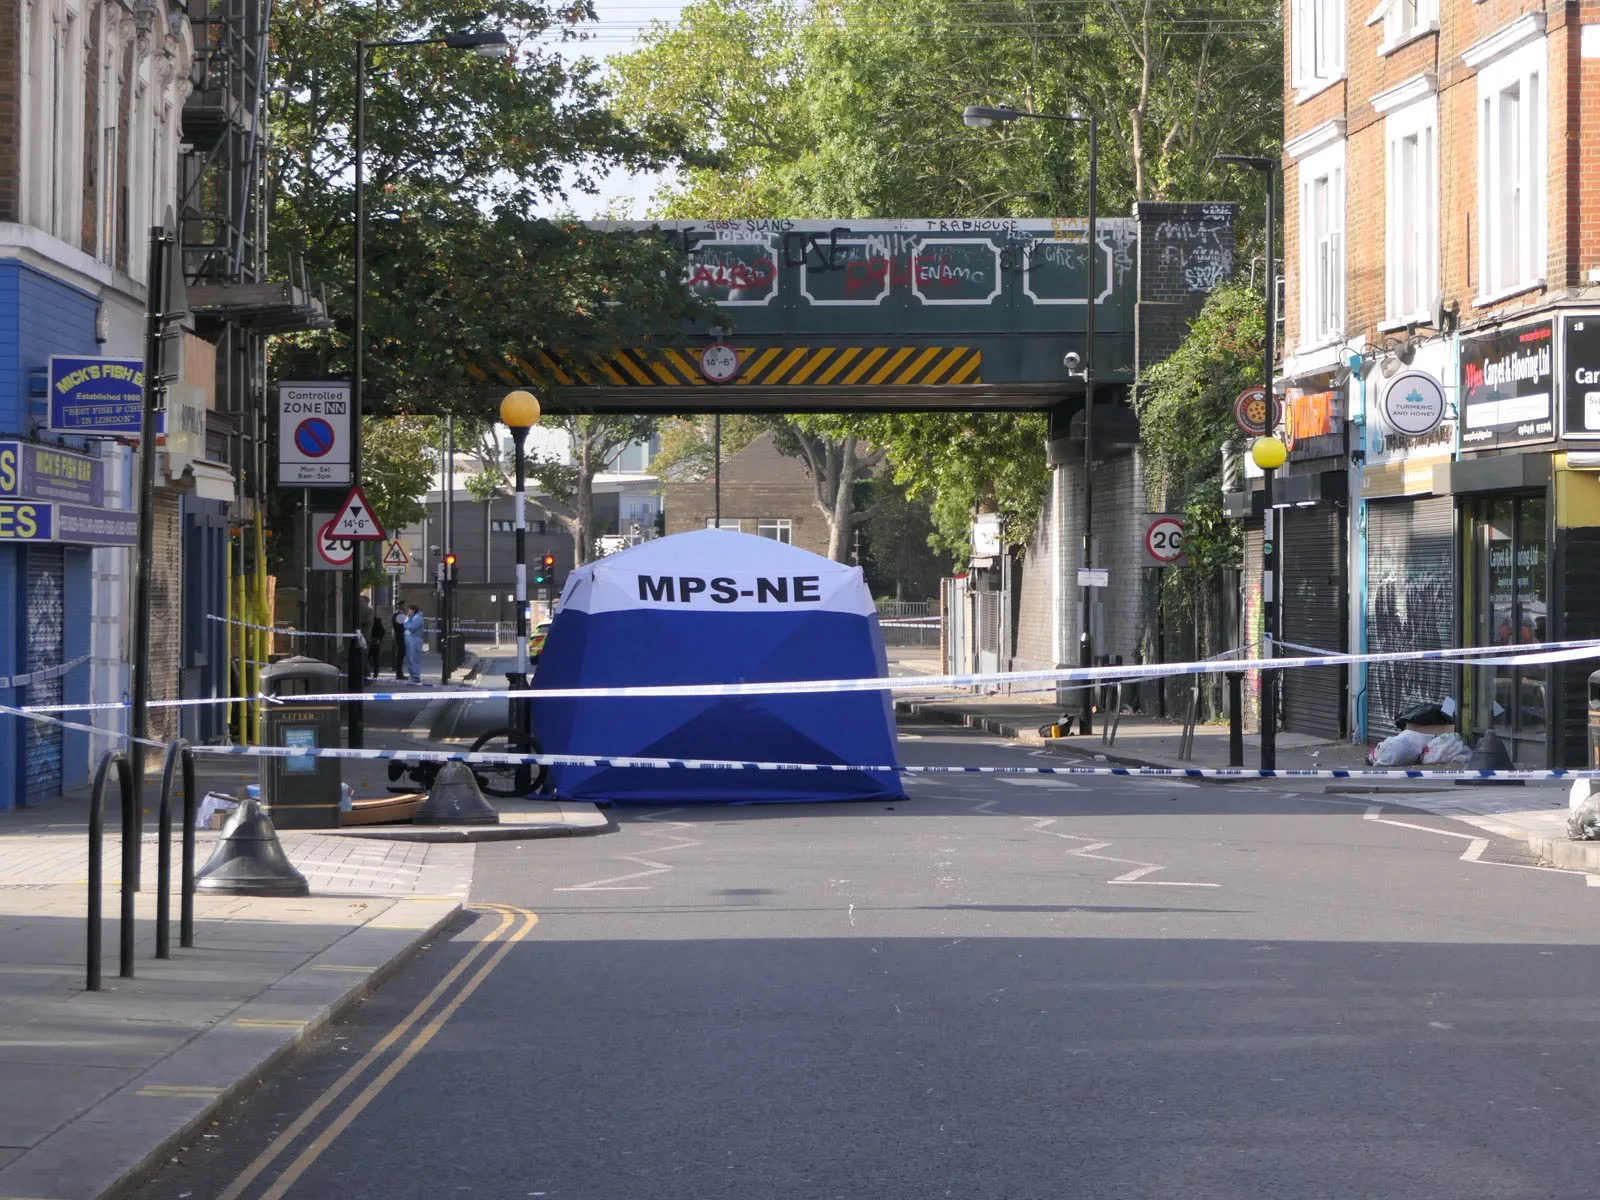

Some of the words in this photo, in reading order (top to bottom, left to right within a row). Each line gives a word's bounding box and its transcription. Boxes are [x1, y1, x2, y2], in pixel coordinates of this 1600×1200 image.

[746, 219, 794, 232] SLANG
[927, 220, 1019, 233] TRAPHOUSE
[1539, 344, 1550, 377] Ltd
[56, 365, 100, 394] MICK'S
[102, 364, 133, 381] FISH
[76, 392, 121, 401] Established
[287, 390, 343, 400] Controlled
[283, 402, 322, 414] ZONE
[326, 402, 346, 414] NN
[637, 573, 822, 605] MPS-NE
